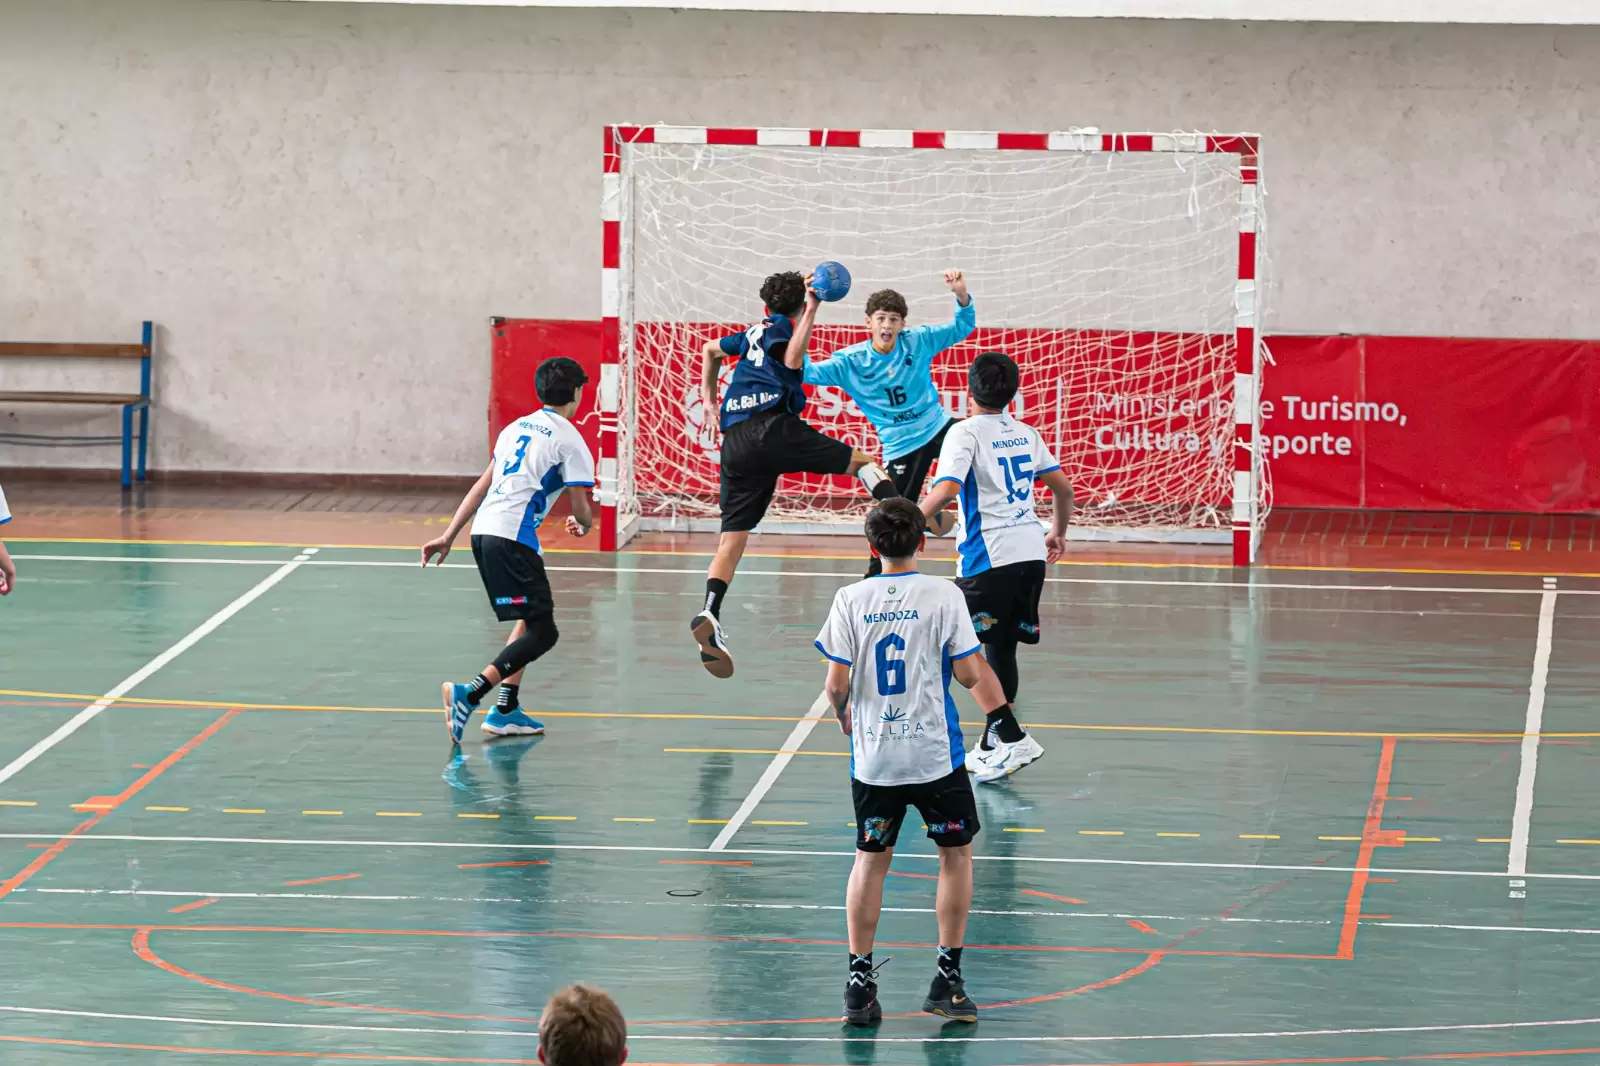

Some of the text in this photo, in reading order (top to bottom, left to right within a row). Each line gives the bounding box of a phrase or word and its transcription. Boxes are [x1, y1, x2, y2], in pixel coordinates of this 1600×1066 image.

[884, 385, 907, 407] 16
[1096, 393, 1233, 418] Ministerio
[1281, 395, 1407, 427] Turismo,
[519, 420, 553, 438] MENDOZA
[992, 437, 1029, 449] MENDOZA
[1095, 425, 1352, 459] Cultura y eporte
[503, 435, 531, 476] 3
[997, 453, 1034, 504] 15
[863, 609, 919, 624] MENDOZA
[875, 632, 907, 696] 6
[866, 722, 924, 737] ALPA
